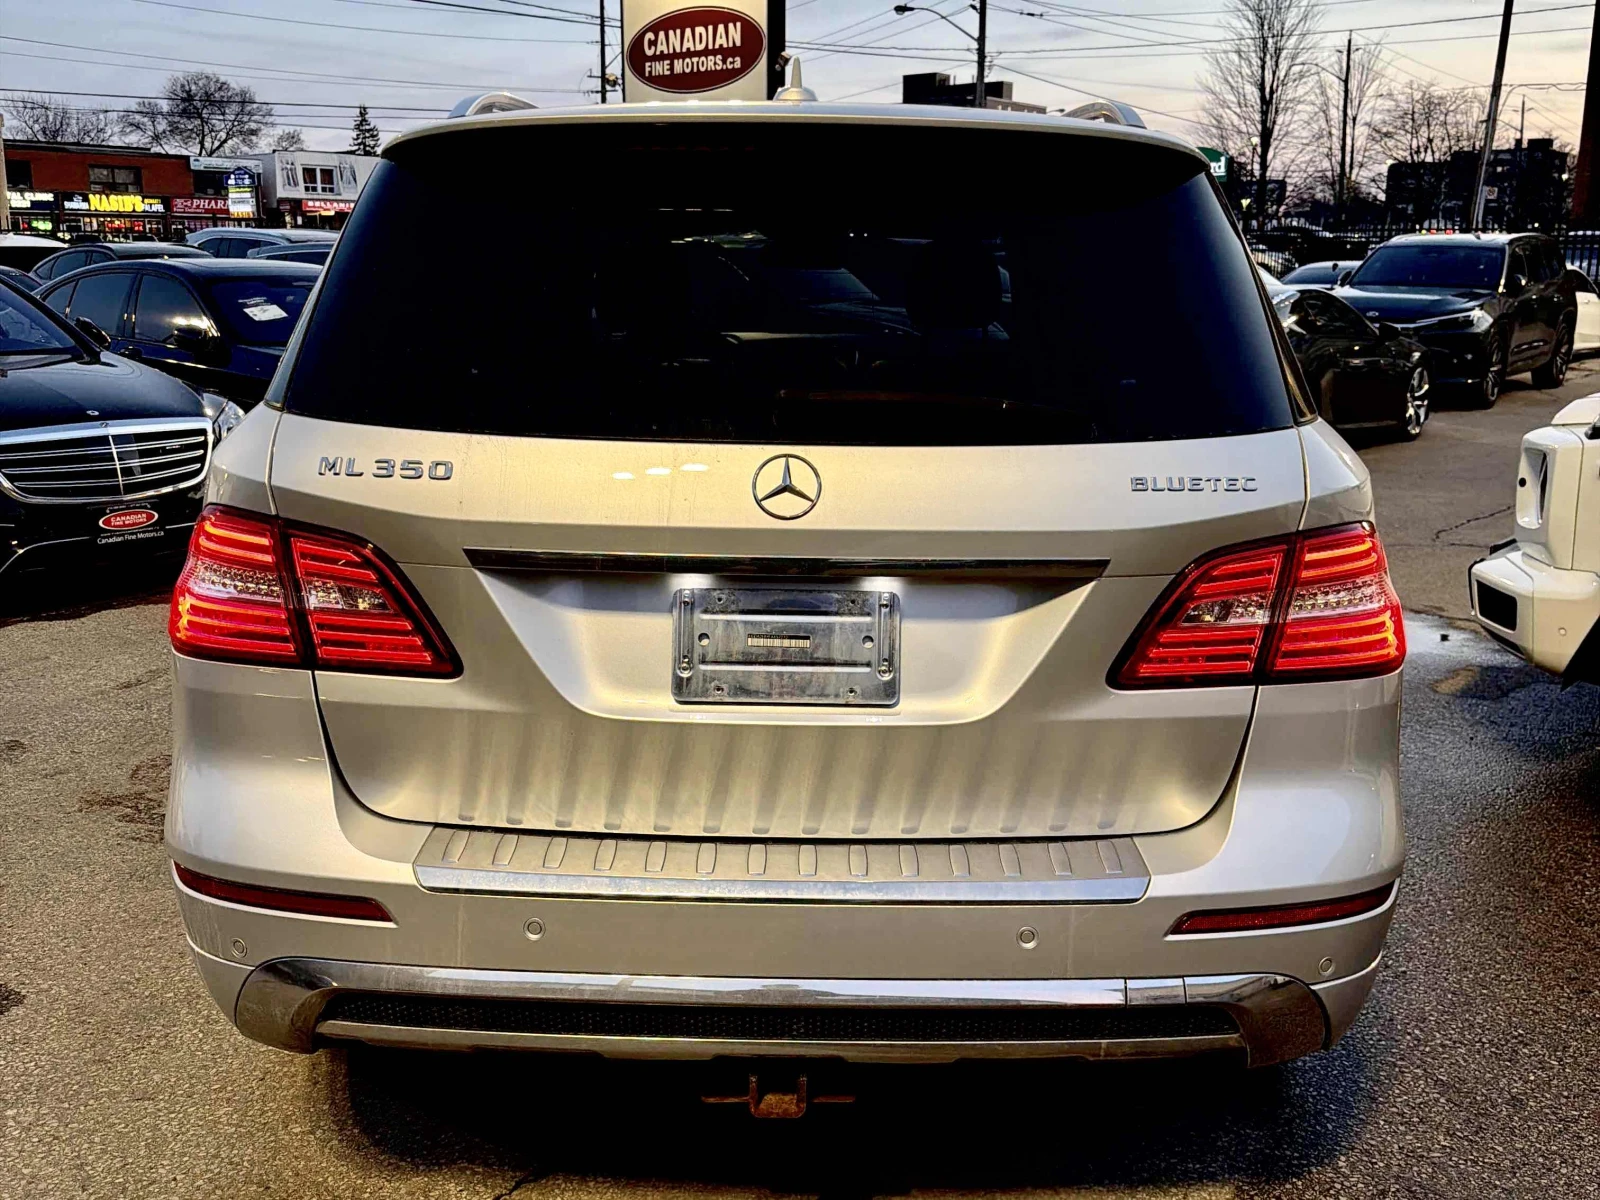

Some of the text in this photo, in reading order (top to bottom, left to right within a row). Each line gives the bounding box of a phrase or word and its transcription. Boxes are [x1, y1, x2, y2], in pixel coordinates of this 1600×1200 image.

[643, 22, 742, 56] CANADIAN
[645, 55, 741, 77] FINE MOTORS.ca
[88, 194, 144, 212] NASIB'S
[318, 456, 453, 481] ML 350
[1130, 476, 1258, 492] BLUETEC
[111, 514, 147, 522] CANADIAN
[97, 536, 124, 544] Canadian
[137, 530, 164, 539] Motors.ca
